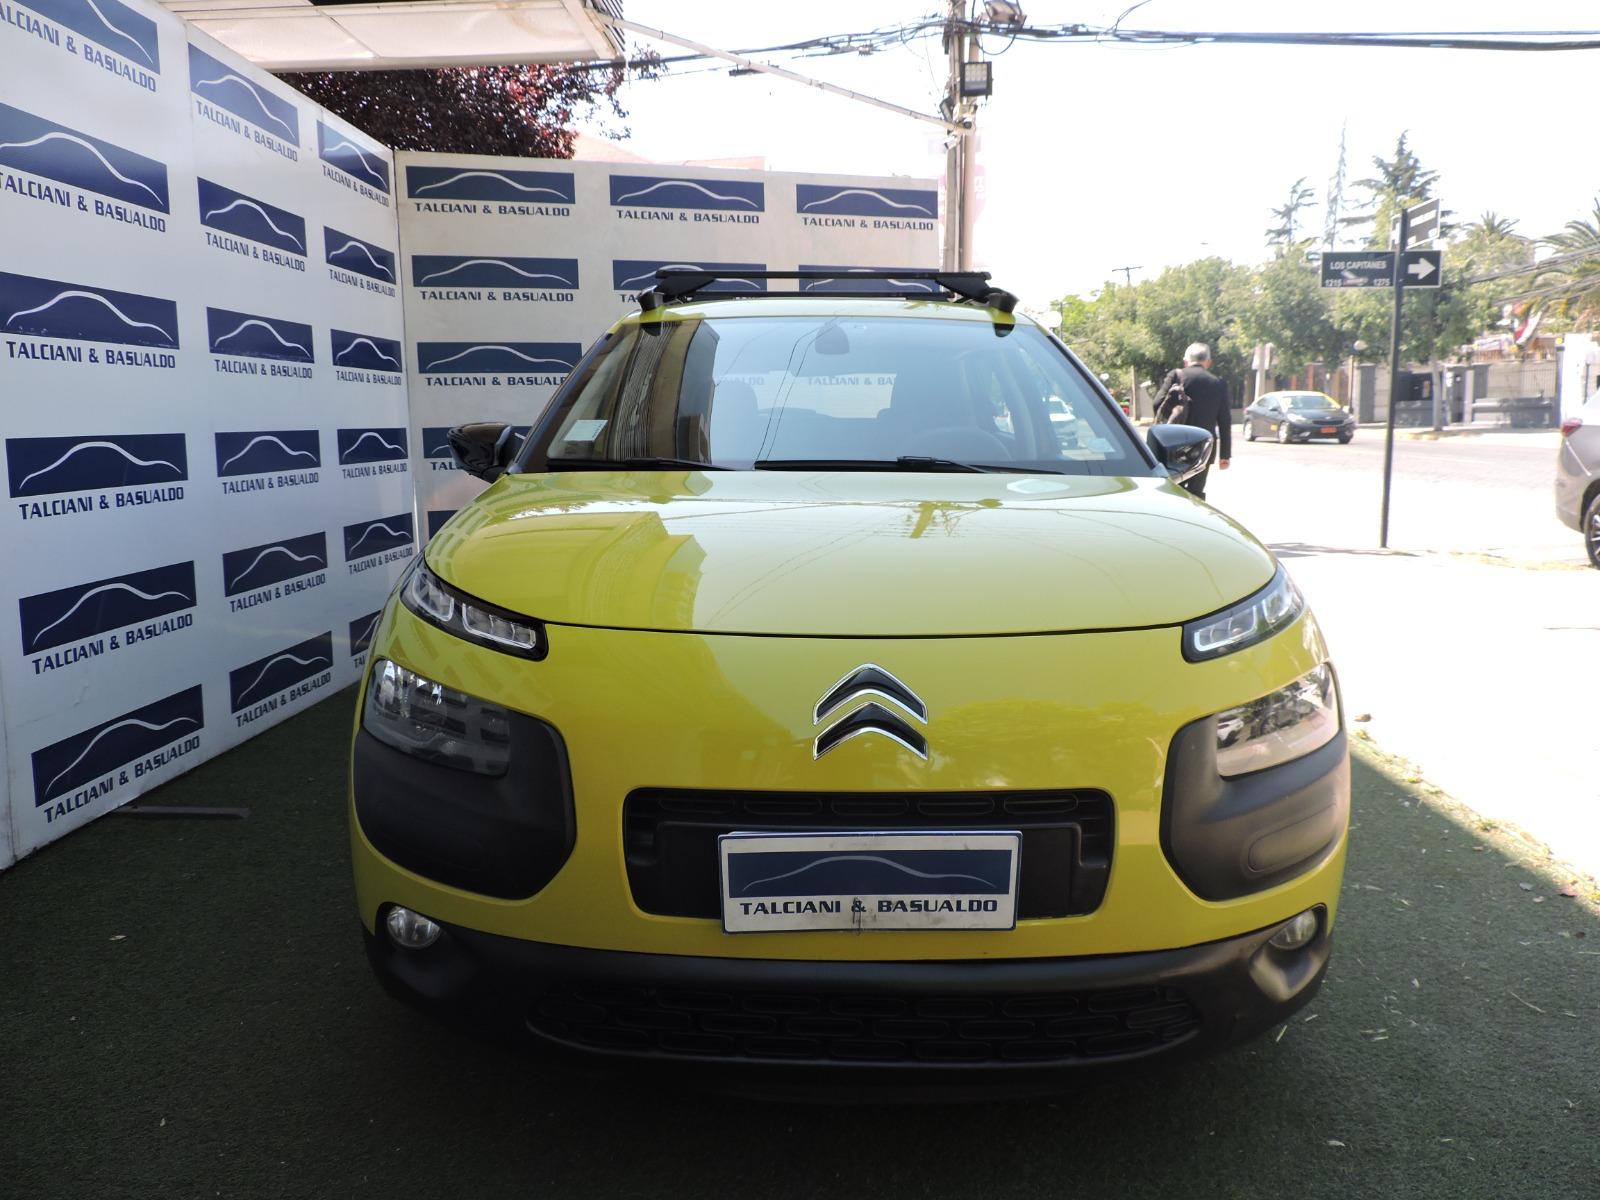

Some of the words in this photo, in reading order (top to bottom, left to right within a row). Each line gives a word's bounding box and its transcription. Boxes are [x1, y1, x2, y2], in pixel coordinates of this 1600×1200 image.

[66, 35, 77, 54] &
[83, 44, 156, 92] BASUALDO
[196, 101, 241, 134] TALCIANI
[244, 125, 251, 139] &
[254, 131, 298, 162] BASUALDO
[322, 165, 352, 191] TALCIANI
[353, 182, 358, 192] &
[77, 195, 88, 212] &
[95, 199, 166, 233] BASUALDO
[415, 202, 477, 214] TALCIANI
[482, 204, 492, 214] &
[499, 205, 570, 217] BASUALDO
[616, 210, 674, 222] TALCIANI
[679, 212, 688, 222] &
[694, 212, 760, 224] BASUALDO
[802, 217, 855, 228] TALCIANI
[859, 220, 868, 229] &
[874, 220, 934, 231] BASUALDO
[205, 232, 250, 256] TALCIANI
[253, 246, 259, 259] &
[262, 250, 306, 272] BASUALDO
[1330, 261, 1344, 270] LOS
[1346, 260, 1387, 270] CAPITANES
[329, 268, 358, 287] TALCIANI
[420, 290, 482, 302] TALCIANI
[487, 291, 497, 302] &
[502, 291, 574, 302] BASUALDO
[6, 340, 82, 363] TALCIANI
[88, 348, 100, 364] &
[106, 350, 176, 369] BASUALDO
[214, 359, 258, 375] TALCIANI
[261, 364, 268, 376] &
[270, 364, 312, 378] BASUALDO
[336, 370, 365, 382] TALCIANI
[366, 374, 371, 384] &
[425, 376, 486, 386] TALCIANI
[492, 376, 501, 386] &
[508, 376, 566, 386] BASUAL
[342, 466, 370, 479] TALCIANI
[372, 466, 378, 476] &
[222, 478, 265, 495] TALCIANI
[268, 477, 274, 488] &
[278, 472, 320, 487] BASUALDO
[19, 496, 93, 520] TALCIANI
[99, 494, 110, 510] &
[116, 486, 184, 508] BASUALDO
[348, 560, 377, 576] TALCIANI
[378, 556, 383, 566] &
[230, 590, 272, 613] TALCIANI
[275, 588, 281, 599] &
[285, 573, 326, 596] BASUALDO
[32, 640, 104, 674] TALCIANI
[110, 636, 120, 650] &
[126, 613, 193, 645] BASUALDO
[236, 698, 278, 728] TALCIANI
[280, 694, 287, 706] &
[290, 672, 331, 702] BASUALDO
[44, 777, 114, 824] TALCIANI
[119, 770, 129, 786] &
[134, 736, 200, 778] BASUALDO
[740, 900, 841, 915] TALCIANI
[851, 900, 866, 914] &
[878, 900, 998, 914] BASUALDO
